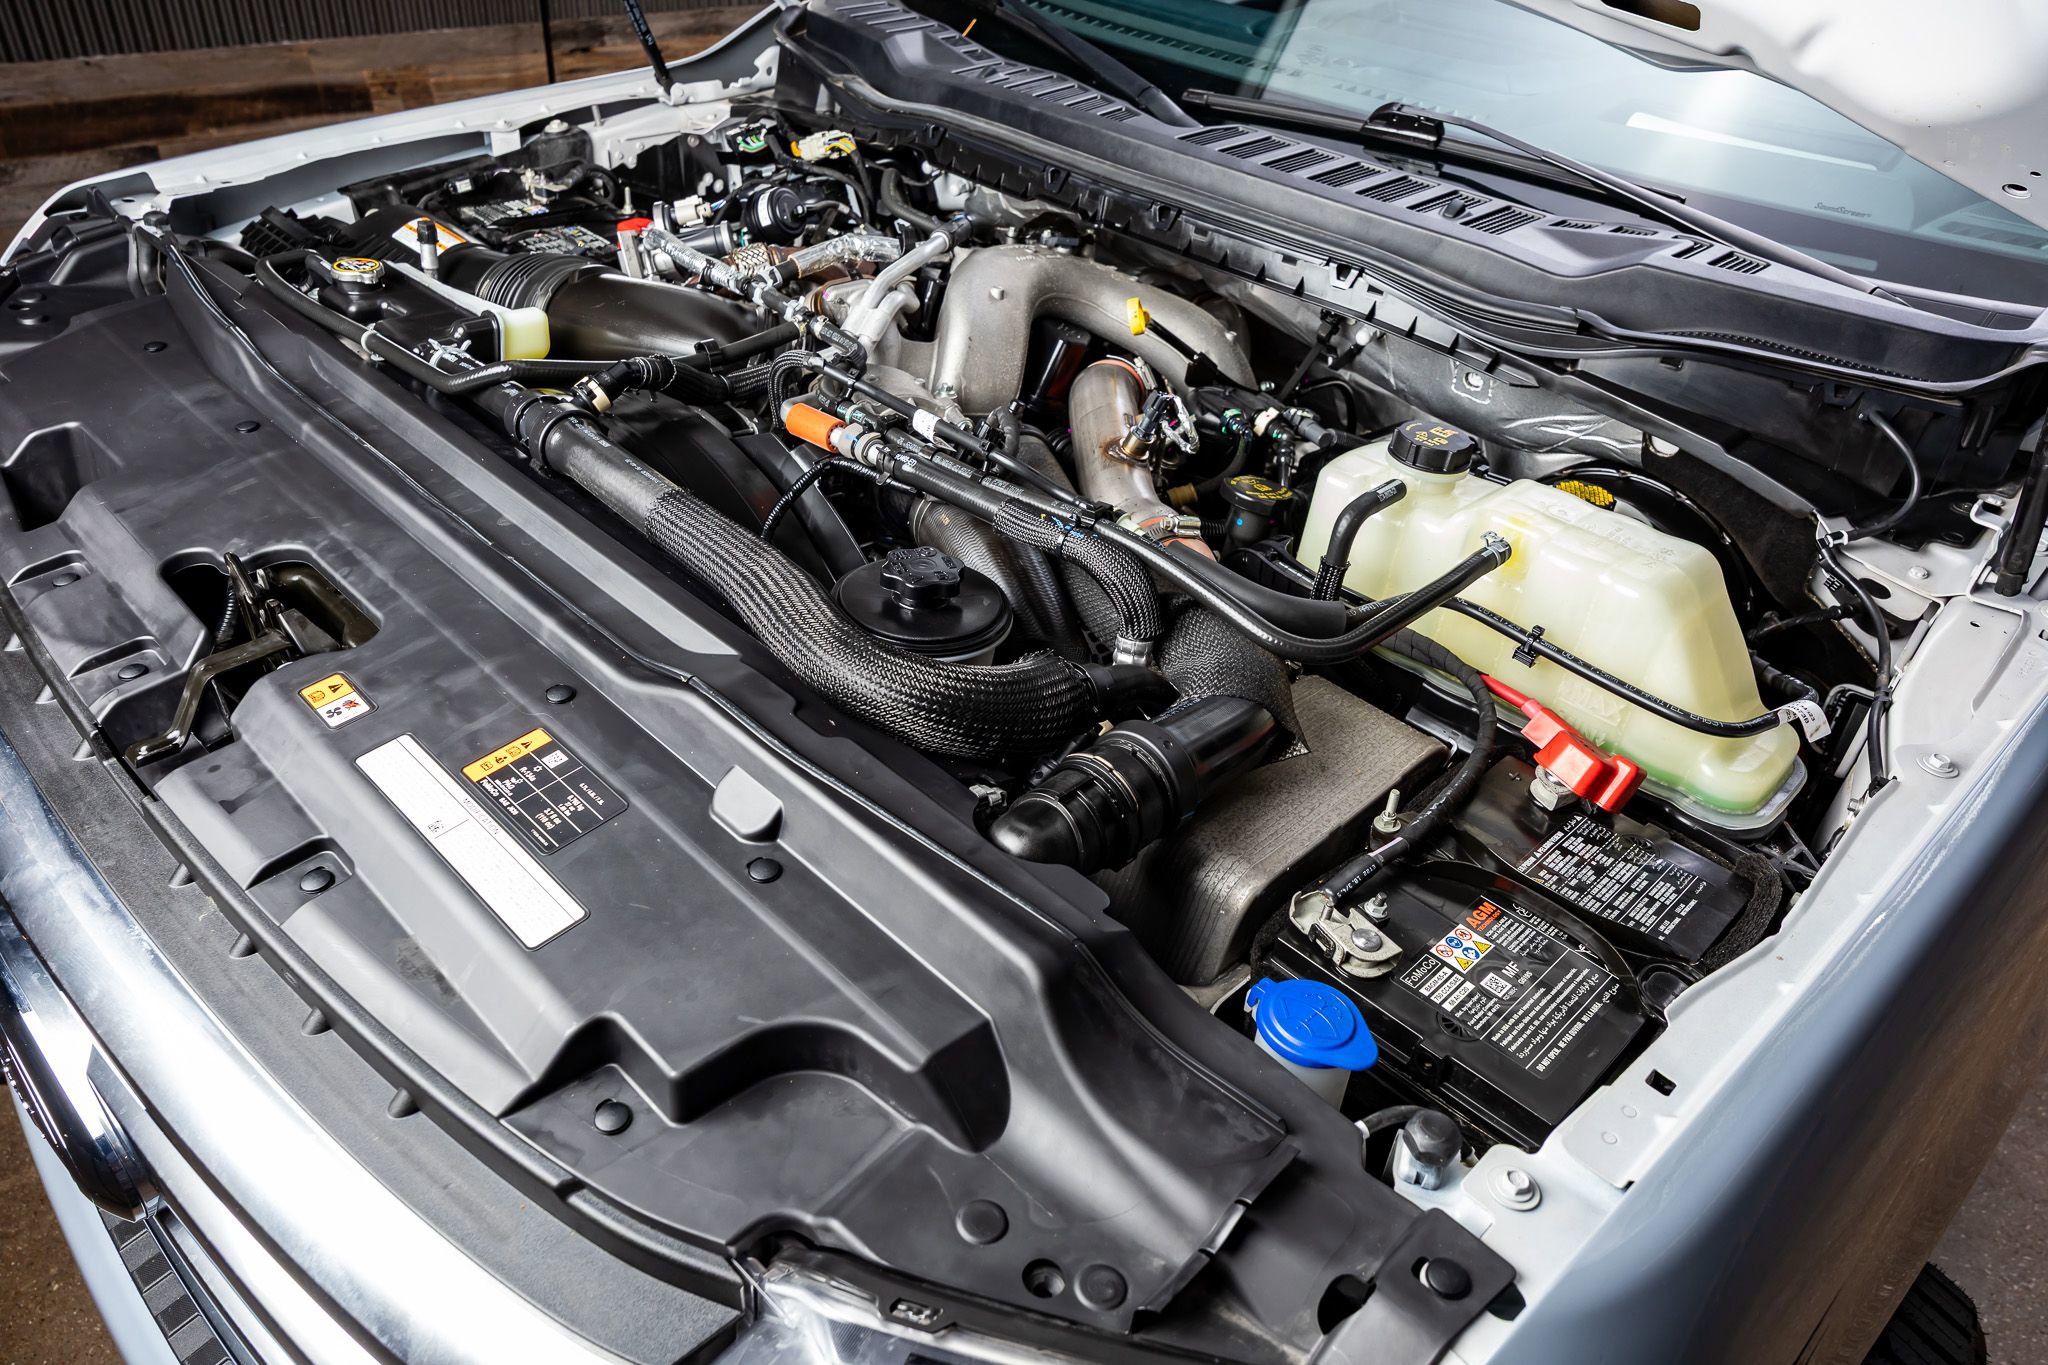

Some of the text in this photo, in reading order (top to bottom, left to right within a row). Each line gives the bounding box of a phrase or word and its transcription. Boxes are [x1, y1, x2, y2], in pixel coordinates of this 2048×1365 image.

[464, 797, 499, 835] MODIFICATION
[1466, 902, 1496, 928] AGM
[1476, 910, 1501, 932] TECHNOLOGY
[1404, 957, 1437, 986] FoMoCo
[1502, 961, 1519, 978] MF
